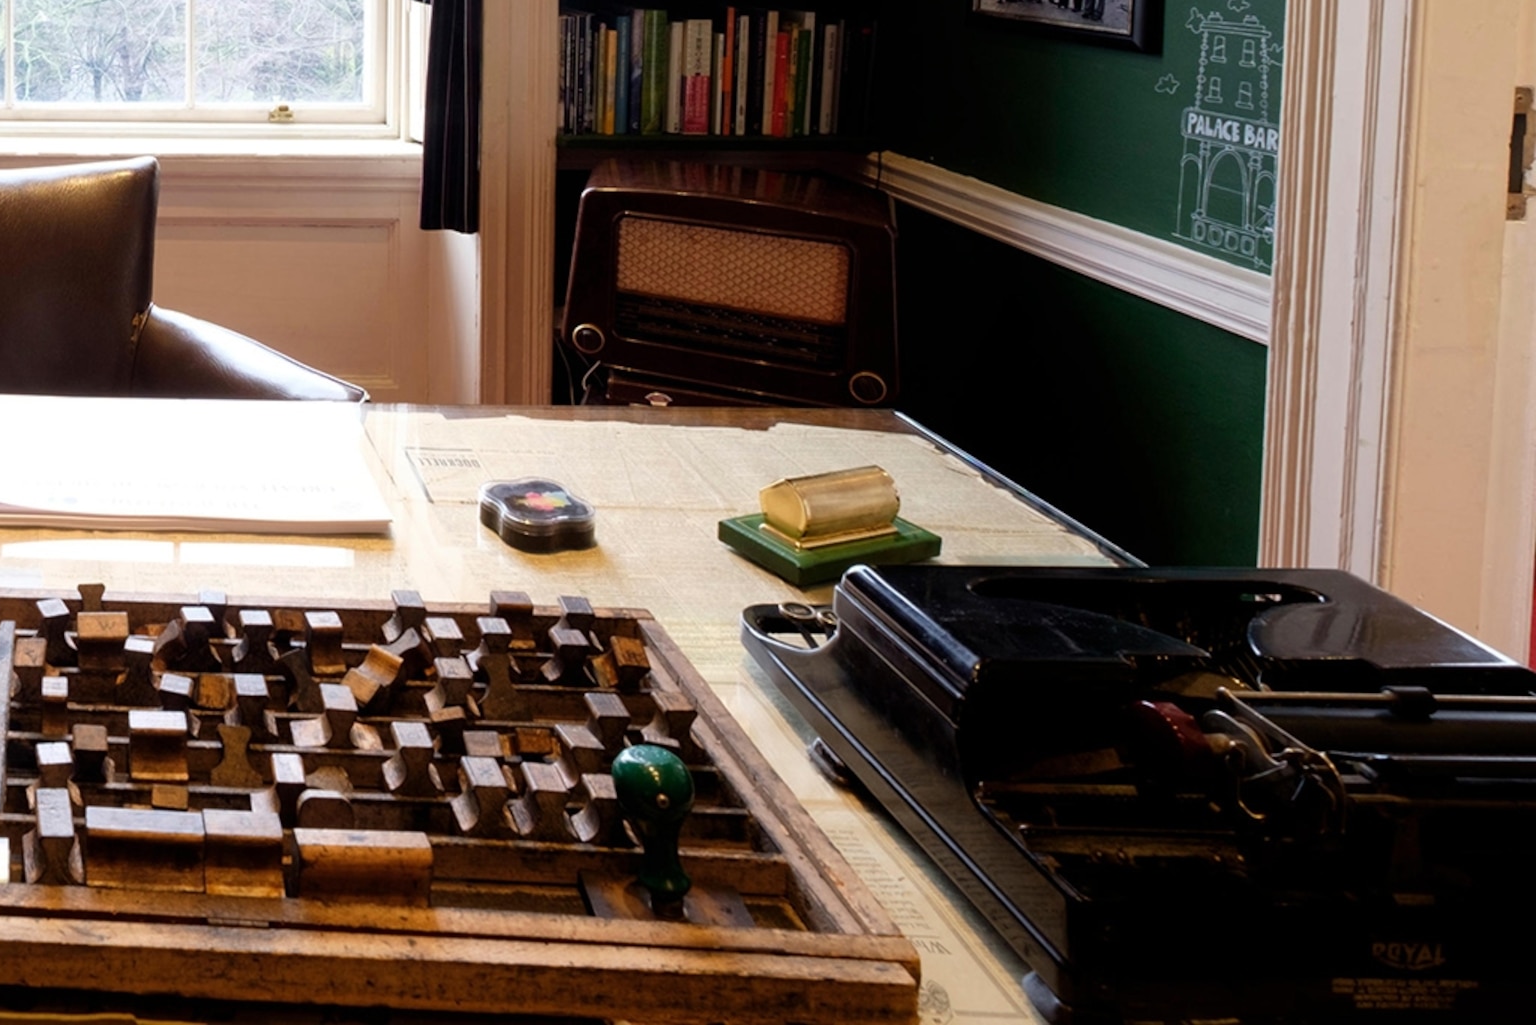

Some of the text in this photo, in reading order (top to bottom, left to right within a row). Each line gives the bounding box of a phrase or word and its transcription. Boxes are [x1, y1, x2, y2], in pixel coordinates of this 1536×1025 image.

[1187, 113, 1280, 151] PALACE BAR
[1371, 942, 1447, 967] ROYAL
